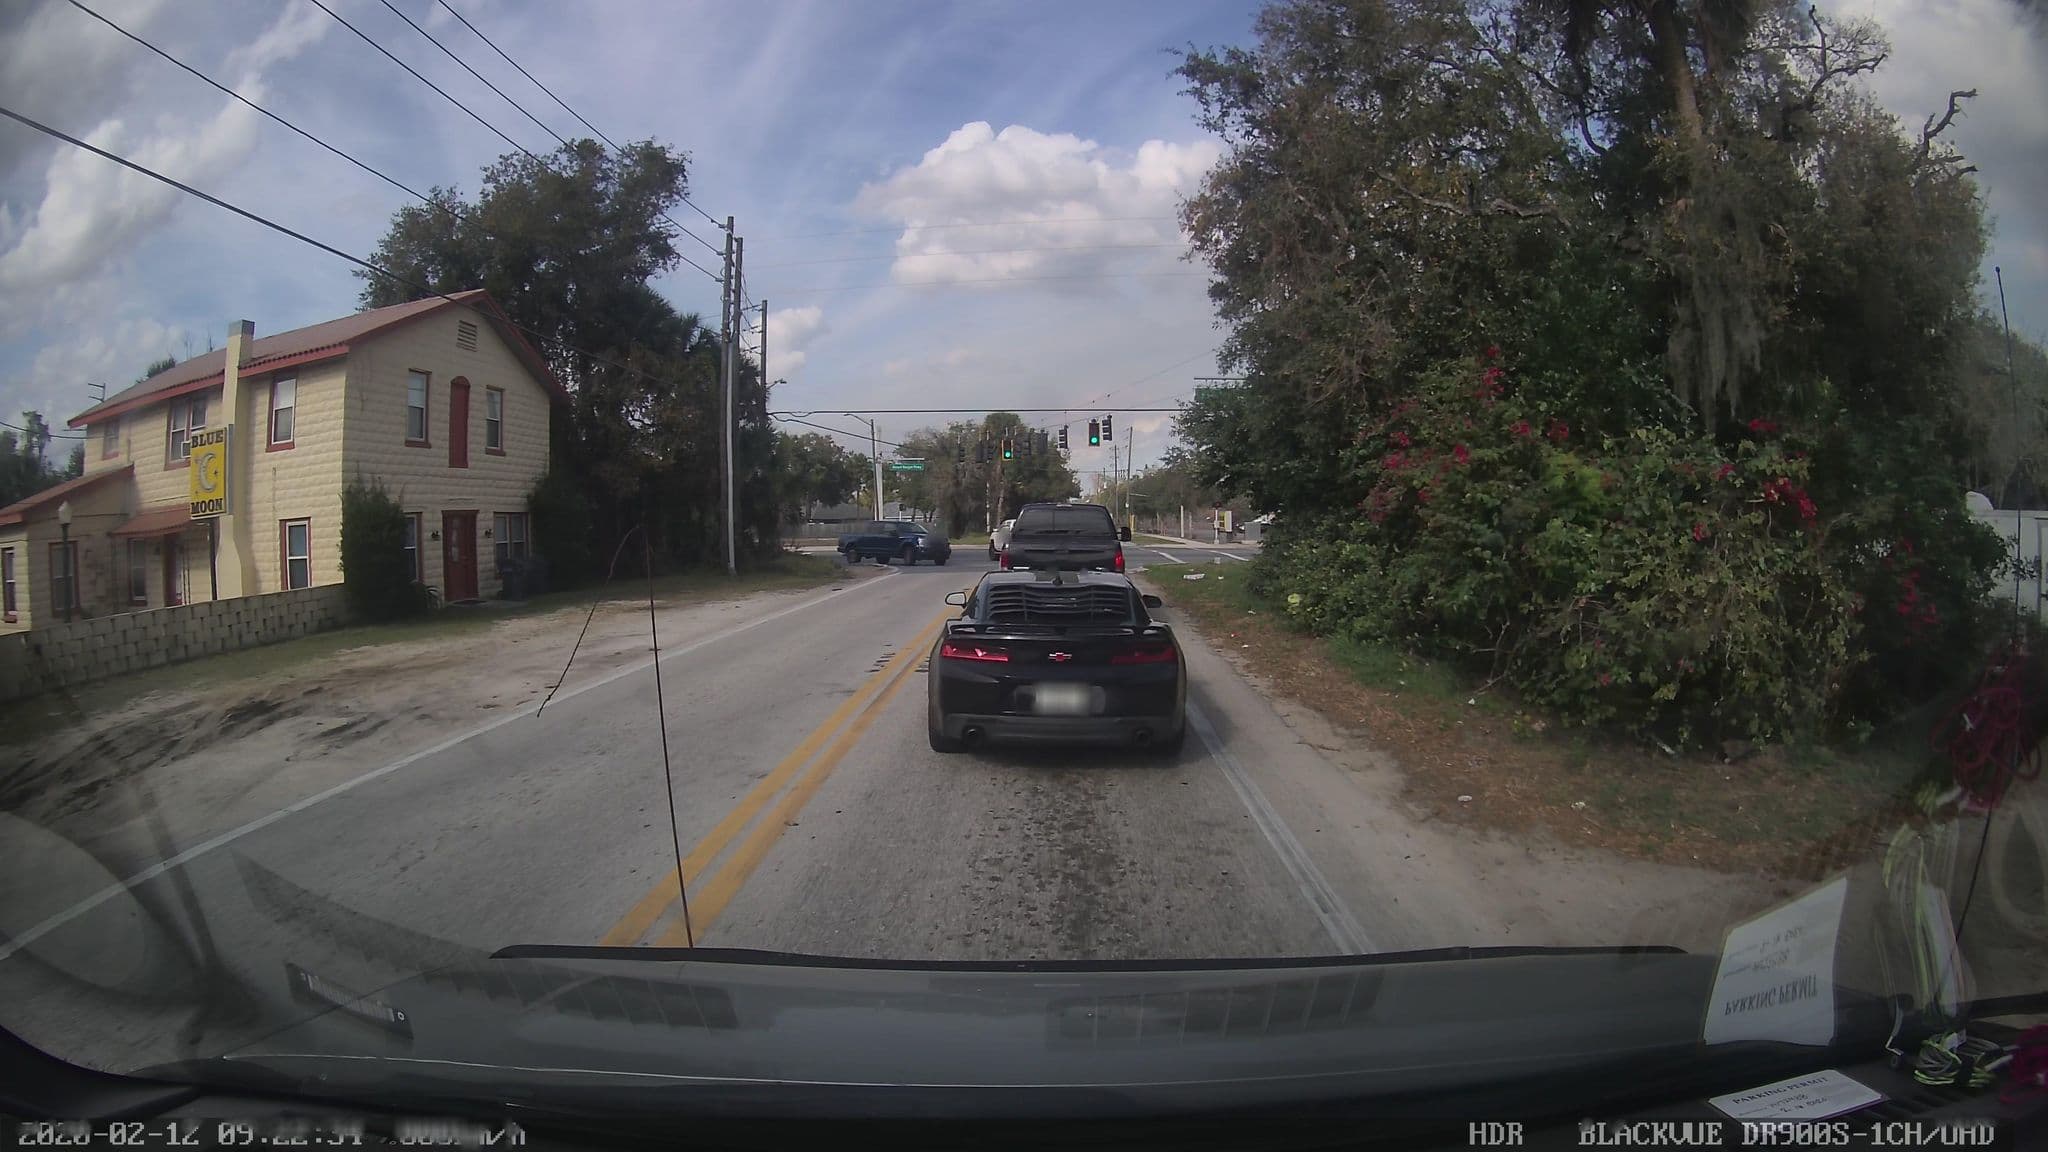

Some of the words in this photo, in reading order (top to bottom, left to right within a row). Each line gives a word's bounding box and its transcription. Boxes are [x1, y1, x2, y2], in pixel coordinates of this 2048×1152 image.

[191, 430, 223, 448] BLUE
[190, 498, 223, 514] MOON
[1732, 1088, 1786, 1105] PARKING
[1788, 1077, 1828, 1091] PERMIT
